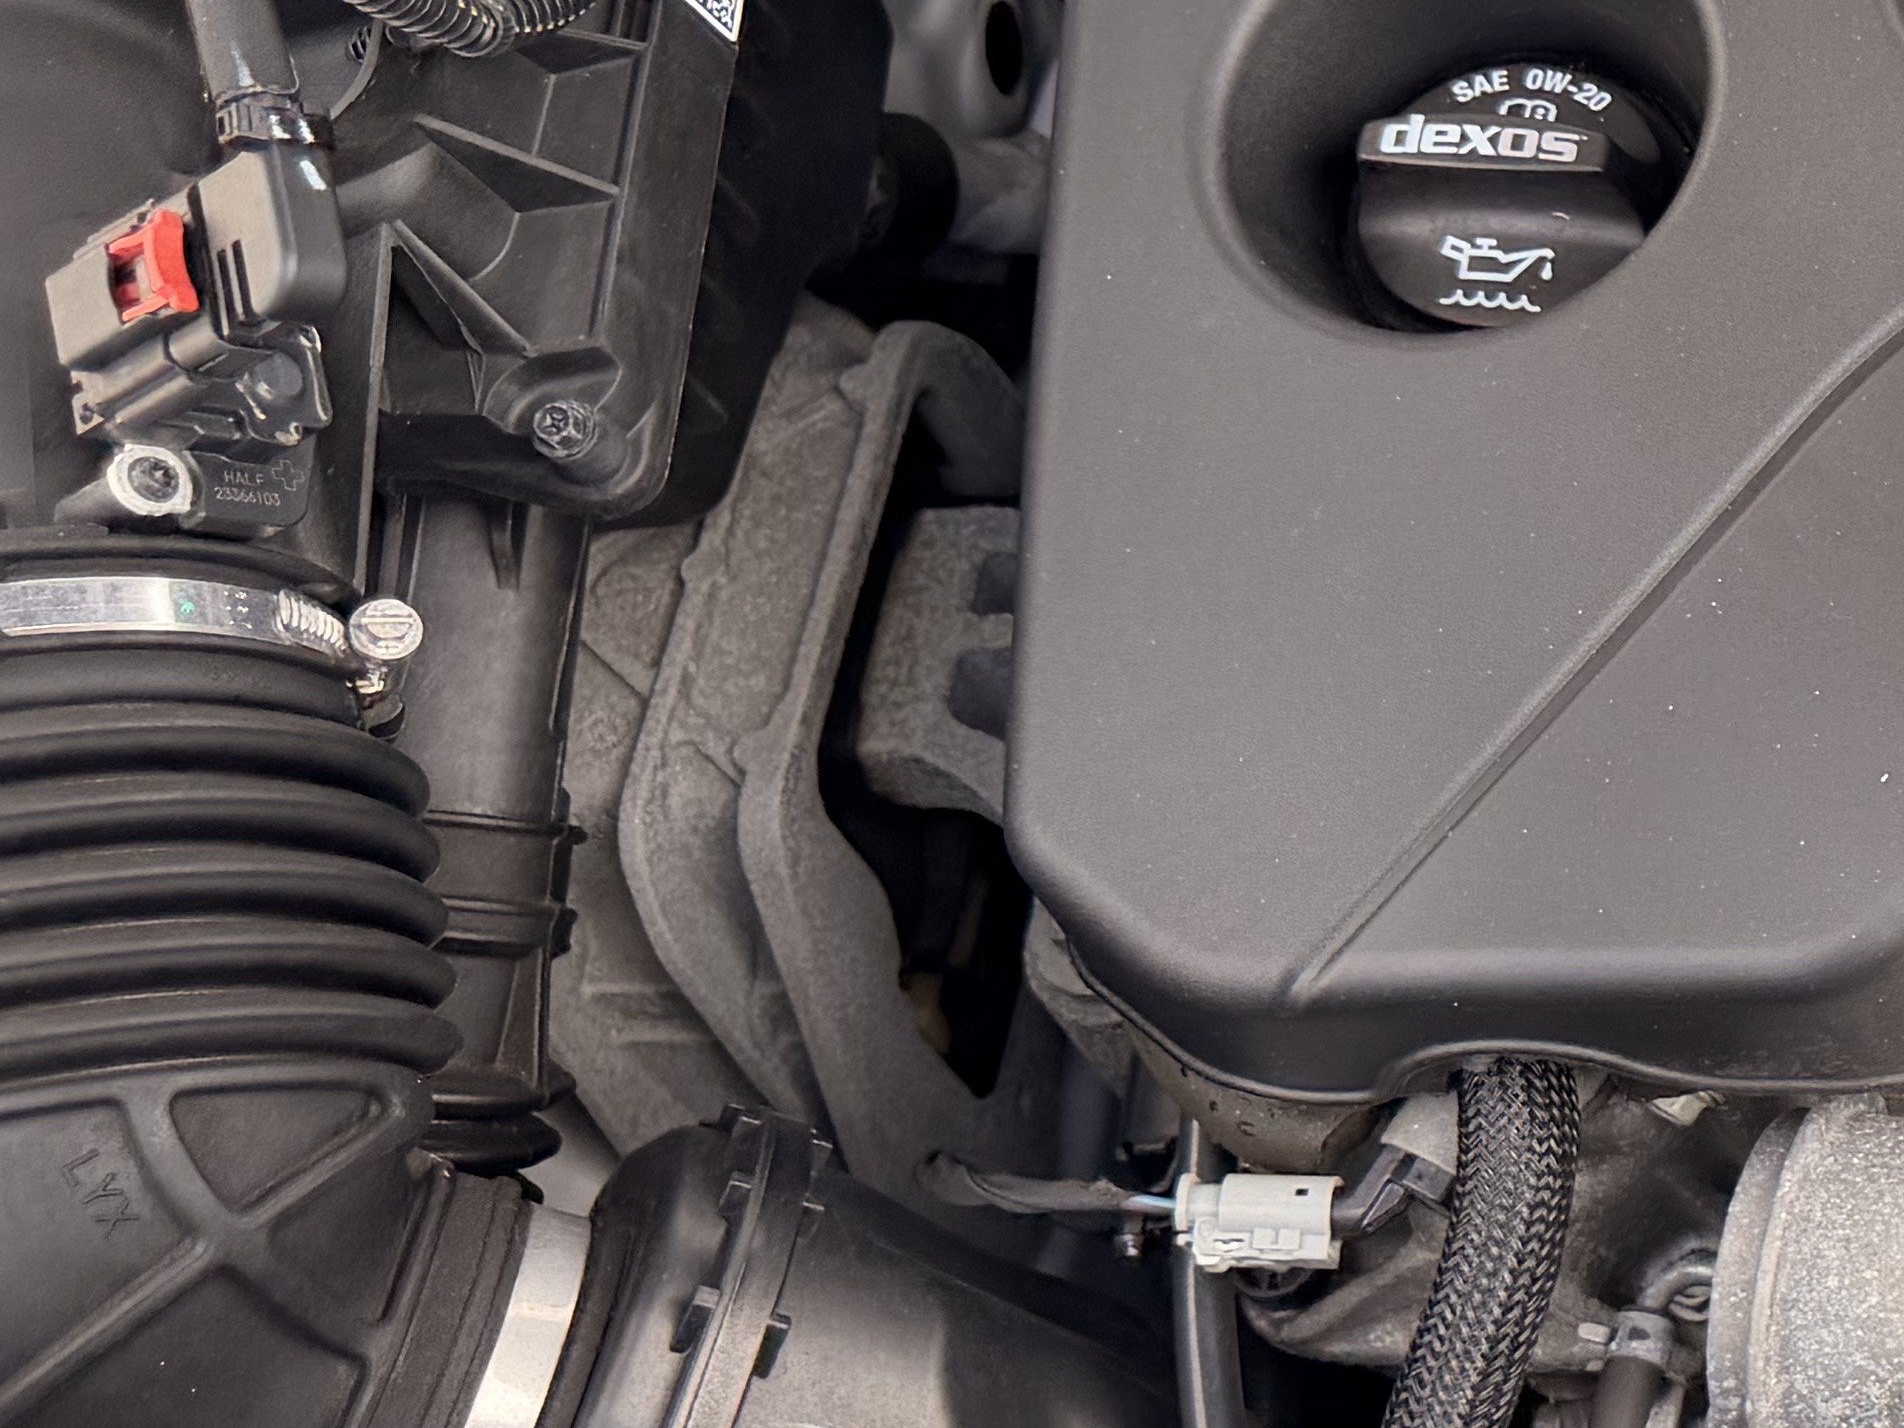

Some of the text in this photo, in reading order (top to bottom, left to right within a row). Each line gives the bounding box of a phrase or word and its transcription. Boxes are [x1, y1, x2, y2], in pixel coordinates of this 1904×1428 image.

[1452, 68, 1613, 113] SAE 0W-20
[1380, 114, 1580, 162] dexos
